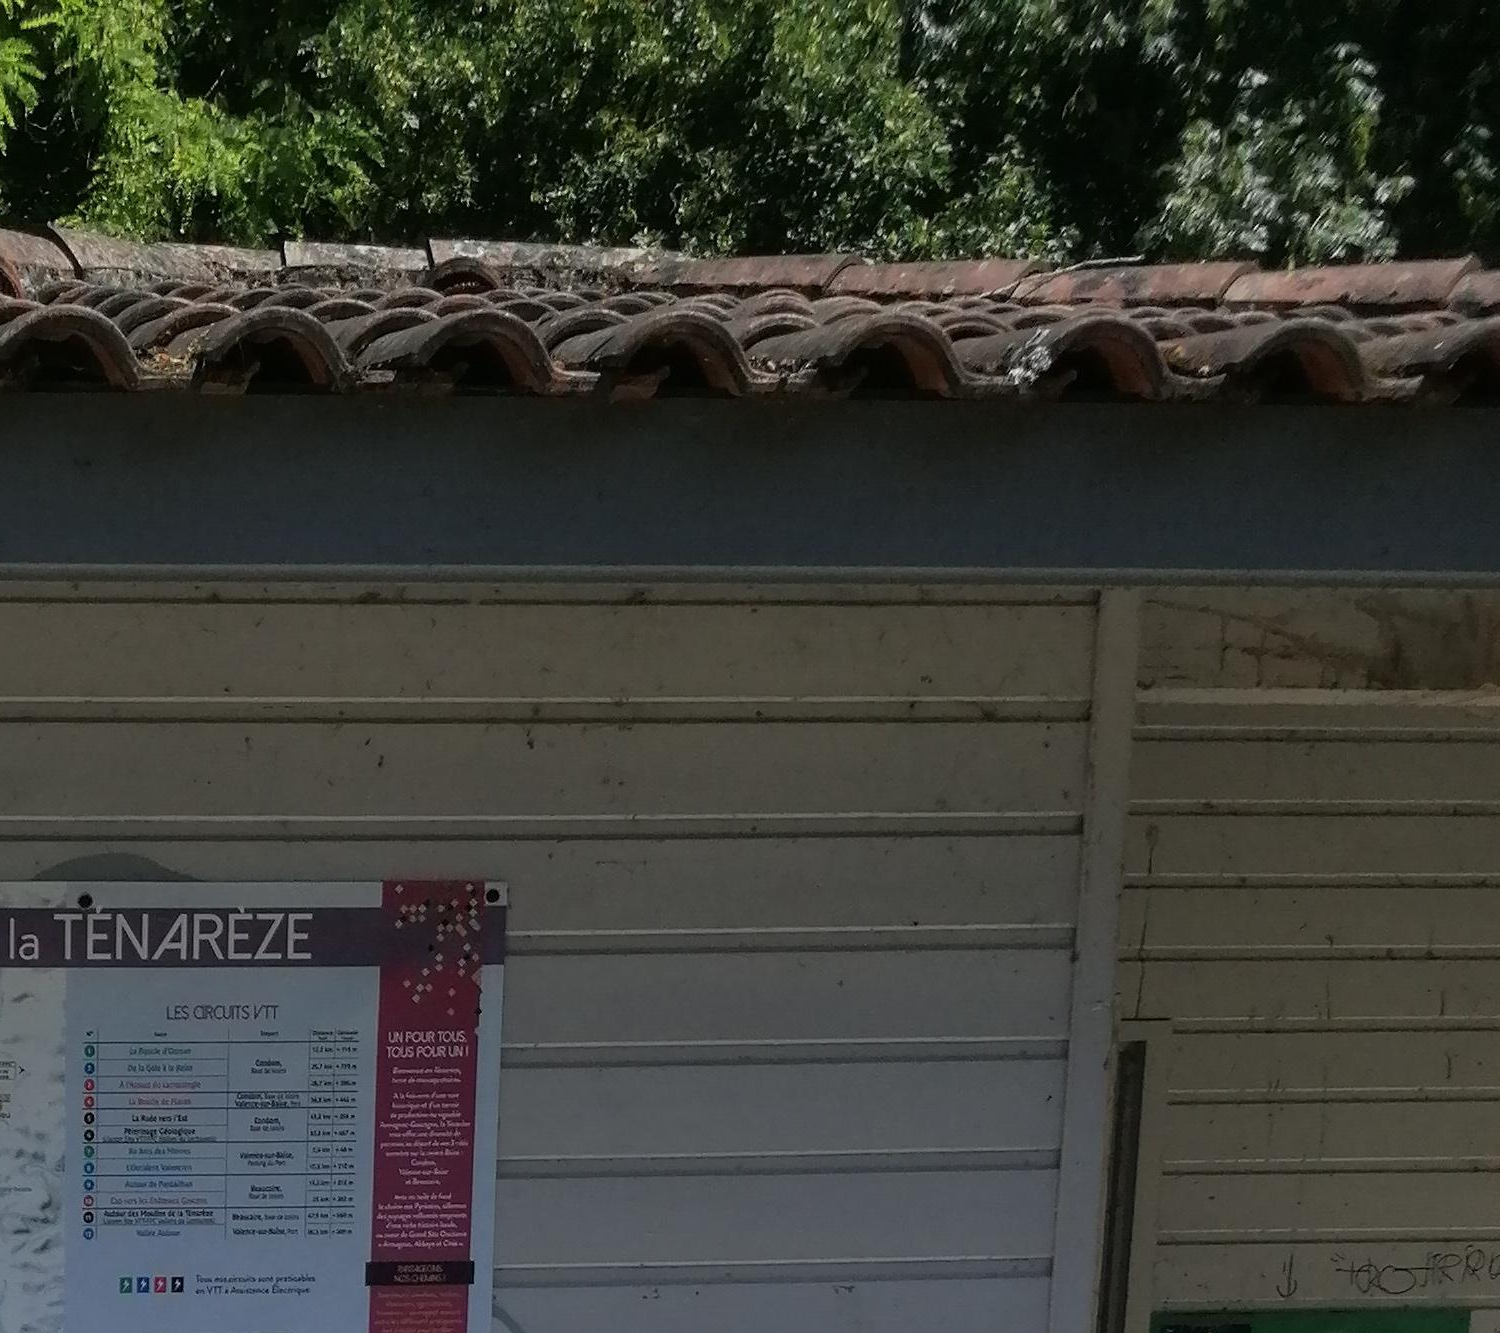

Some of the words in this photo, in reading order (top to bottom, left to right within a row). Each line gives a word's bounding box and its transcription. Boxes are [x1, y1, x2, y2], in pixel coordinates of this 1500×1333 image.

[10, 917, 39, 960] la
[53, 906, 313, 960] TÉNARÈZE
[166, 1005, 189, 1019] LES
[193, 1005, 249, 1019] CIRCUITS
[253, 1005, 279, 1019] VTT
[389, 1031, 403, 1043] UN
[406, 1032, 434, 1042] POUR
[387, 1046, 414, 1057] TOUS
[417, 1046, 446, 1057] POUR
[449, 1046, 462, 1057] UN
[258, 1275, 273, 1283] sont
[276, 1274, 316, 1283] praticables
